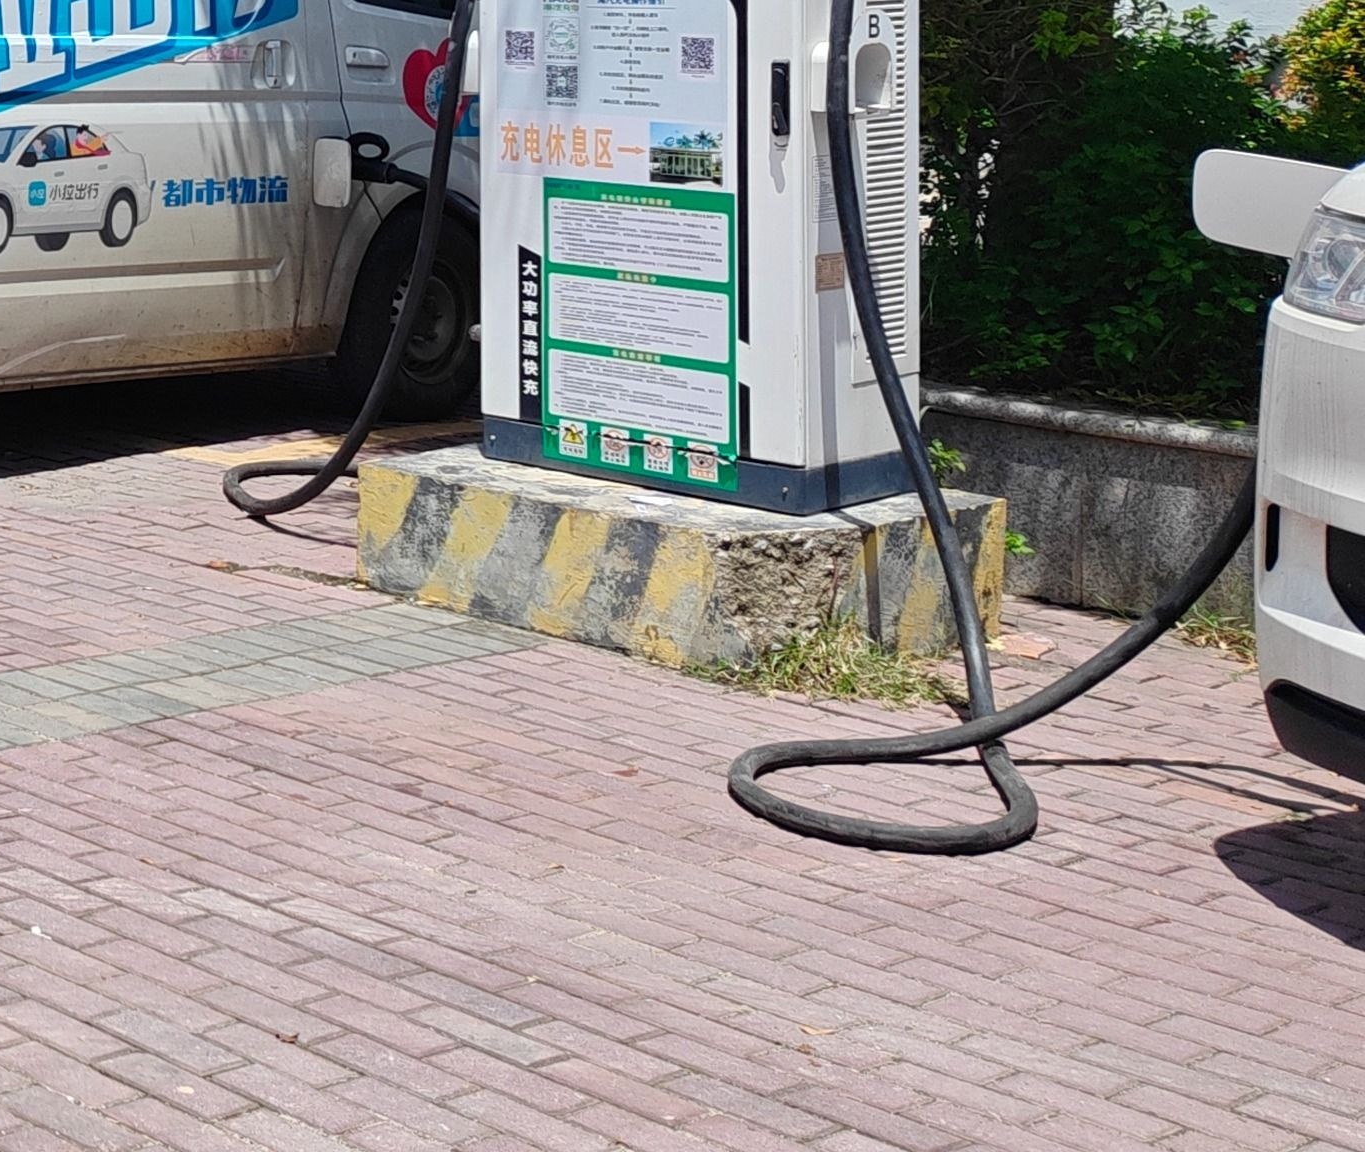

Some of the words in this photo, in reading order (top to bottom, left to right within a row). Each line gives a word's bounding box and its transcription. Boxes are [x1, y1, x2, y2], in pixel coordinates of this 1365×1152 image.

[868, 13, 881, 39] B
[500, 120, 614, 169] 充电休息区
[49, 182, 100, 201] 小拉出行
[162, 174, 289, 207] 都市物流
[521, 260, 539, 396] 大功率直流快充
